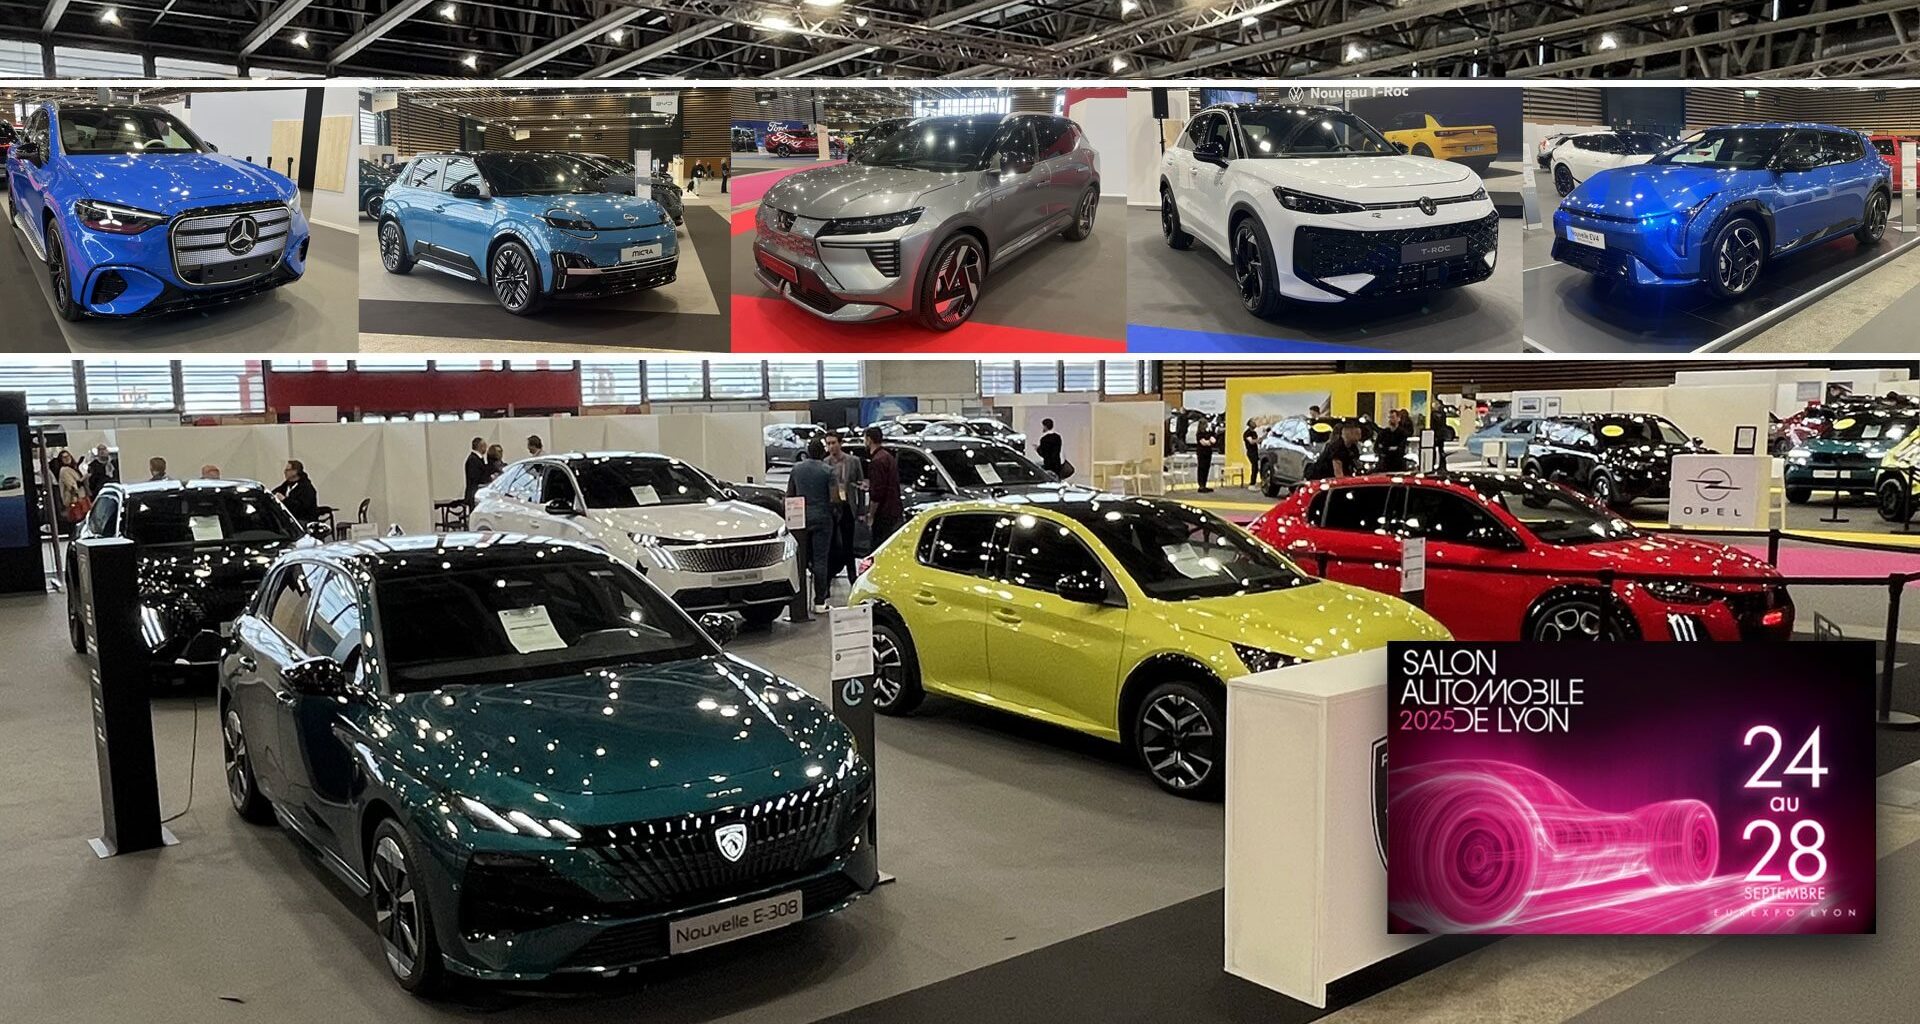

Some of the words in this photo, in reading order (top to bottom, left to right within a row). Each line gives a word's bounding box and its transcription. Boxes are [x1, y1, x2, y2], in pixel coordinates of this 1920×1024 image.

[1310, 87, 1367, 99] Nouveau
[1371, 87, 1409, 97] T-Roc
[767, 121, 789, 132] Ford
[772, 131, 804, 148] Ford
[1589, 233, 1601, 242] EV4
[631, 249, 654, 257] MICRA
[1420, 244, 1451, 255] T-ROC
[1683, 506, 1742, 517] OPEL
[675, 914, 749, 944] Nouvelle
[753, 899, 799, 925] E-308
